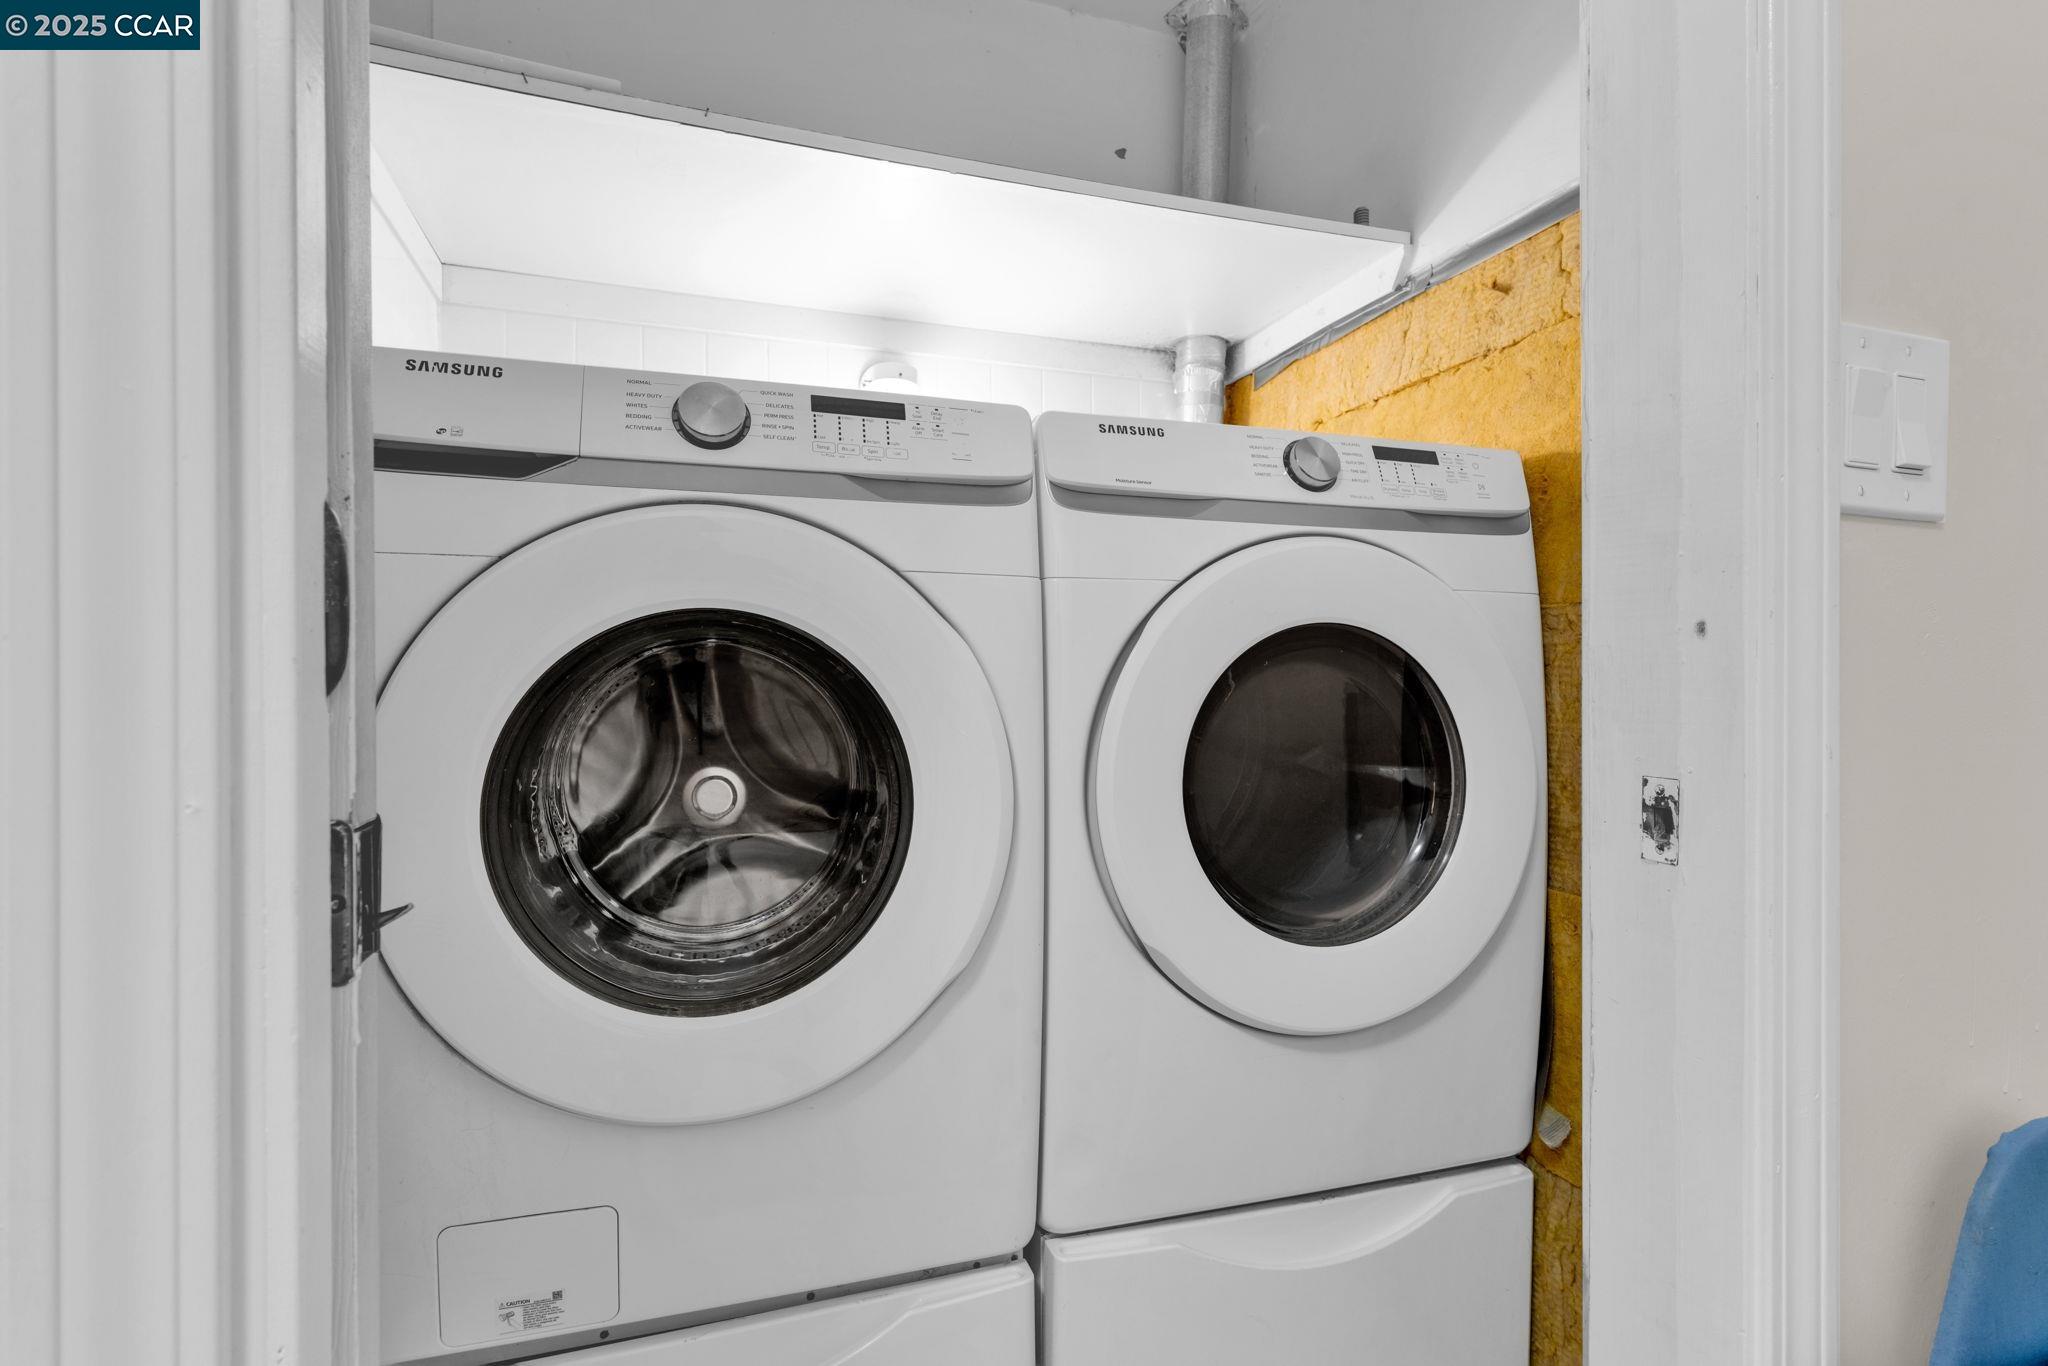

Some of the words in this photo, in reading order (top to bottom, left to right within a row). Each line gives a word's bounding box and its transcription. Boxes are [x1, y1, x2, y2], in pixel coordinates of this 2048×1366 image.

[405, 359, 503, 379] SAMSUNG
[765, 402, 794, 410] DELICATES
[1098, 423, 1165, 438] SAMSUNG
[505, 1299, 531, 1307] CAUTION
